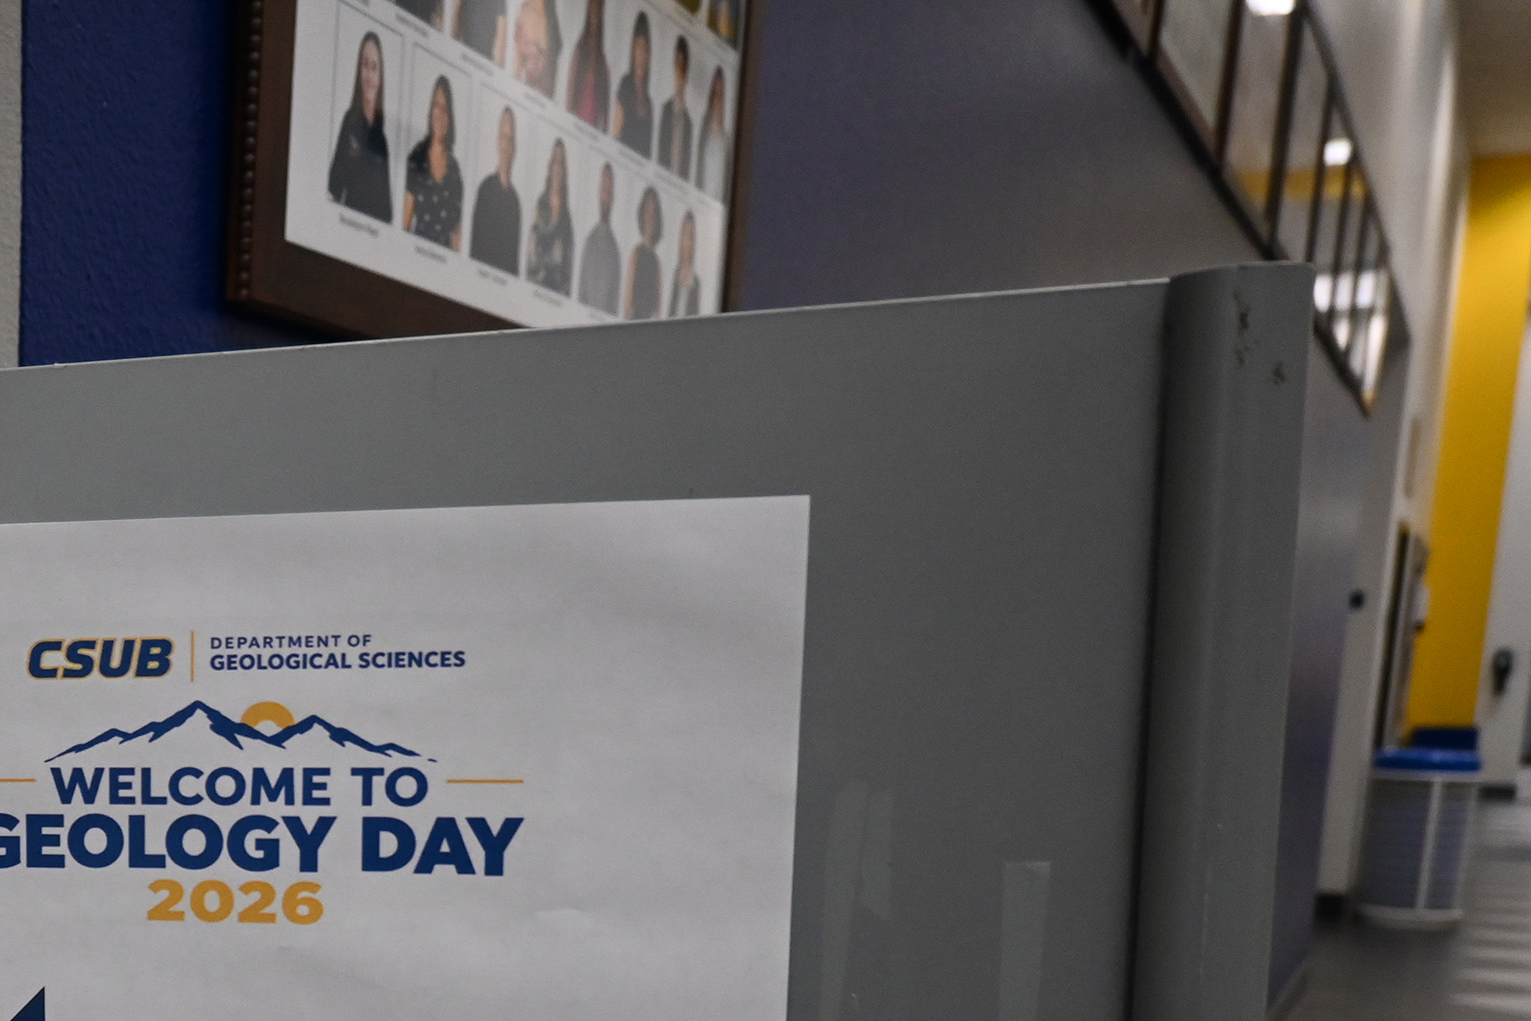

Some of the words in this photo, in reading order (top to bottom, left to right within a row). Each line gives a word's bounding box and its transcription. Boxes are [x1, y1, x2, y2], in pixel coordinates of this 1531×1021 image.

[27, 637, 174, 680] CSUB
[210, 636, 343, 651] DEPARTMENT
[347, 634, 373, 649] OF
[210, 653, 354, 672] GEOLOGICAL
[359, 651, 467, 670] SCIENCES
[50, 767, 333, 807] WELCOME
[351, 767, 430, 808] TO
[361, 817, 526, 878] DAY
[146, 879, 326, 926] 2026
